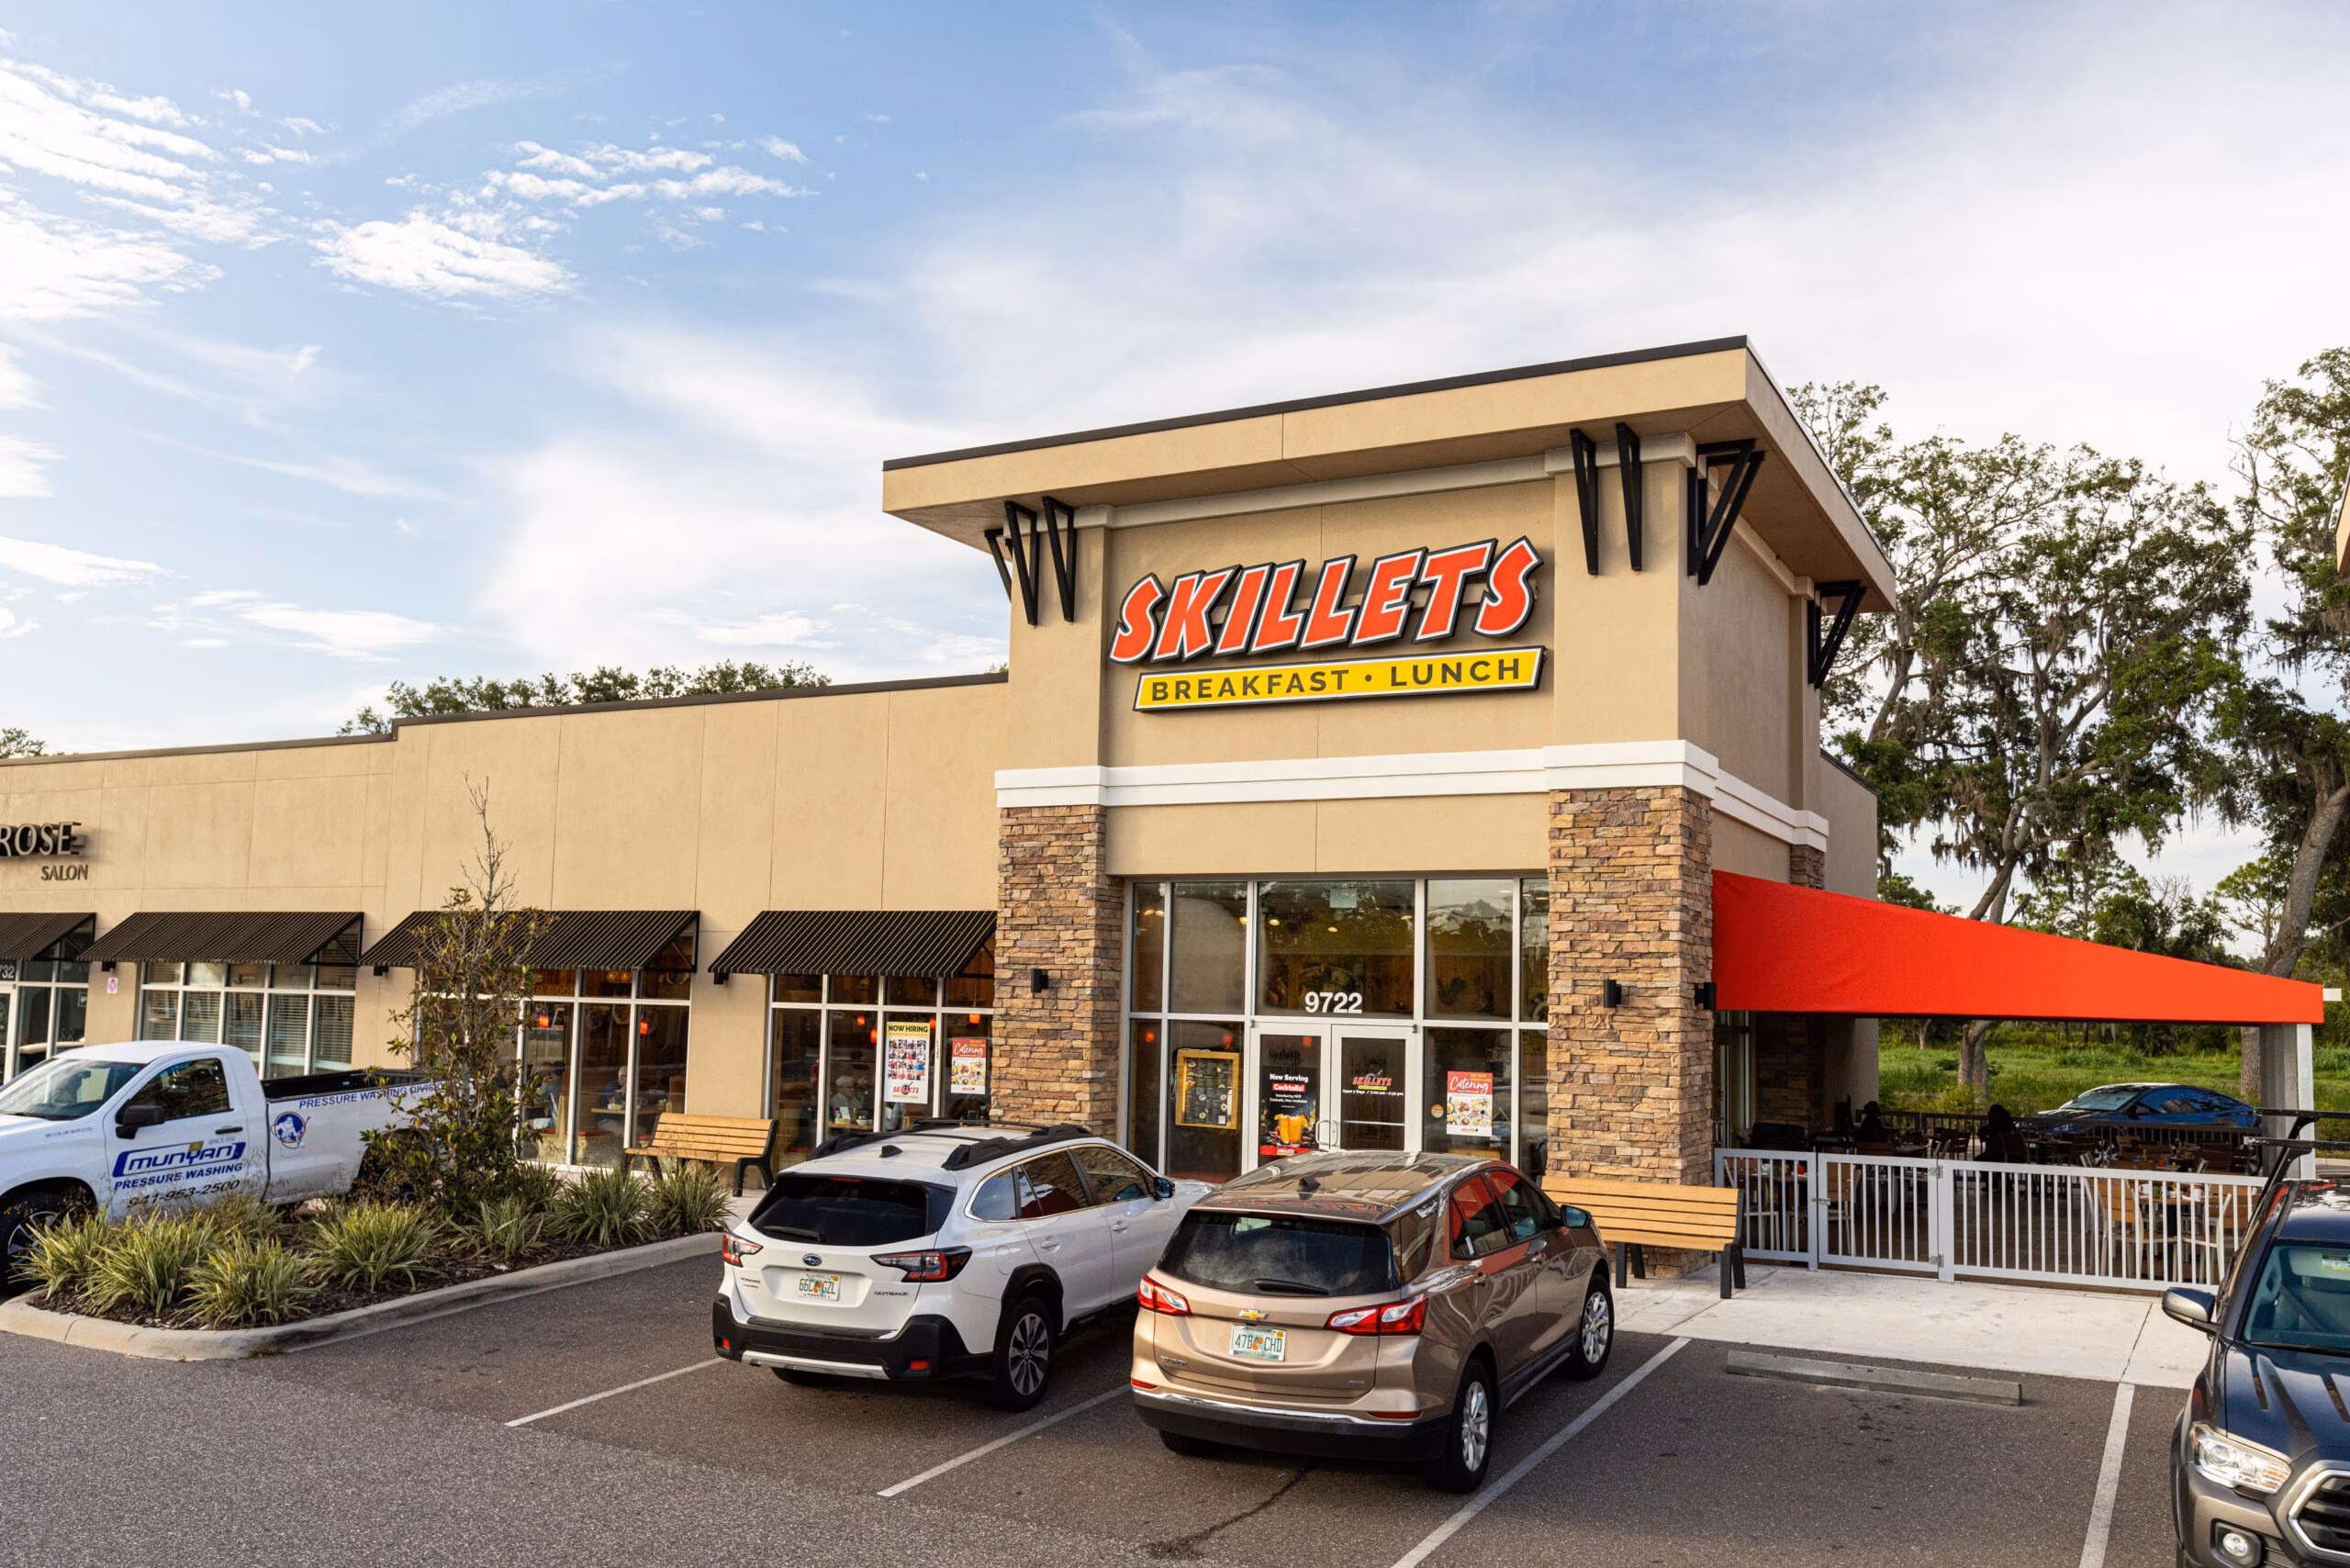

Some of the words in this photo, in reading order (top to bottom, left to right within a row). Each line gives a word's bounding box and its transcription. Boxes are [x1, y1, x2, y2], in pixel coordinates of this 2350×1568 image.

[1107, 535, 1546, 666] SKILLETS
[1150, 666, 1350, 702] BREAKFAST
[1390, 657, 1521, 688] LUNCH
[40, 865, 89, 881] SALON
[1304, 991, 1363, 1014] 9722
[888, 1025, 905, 1033] NOW
[954, 1042, 984, 1058] Catering
[1269, 1073, 1284, 1081] Now
[1283, 1074, 1309, 1083] Serving
[1352, 1076, 1393, 1087] SKILLETS
[1449, 1075, 1489, 1095] Catering
[298, 1093, 358, 1109] PRESSURE
[360, 1086, 408, 1101] WASHING
[409, 1081, 446, 1095] DIVISIO
[1272, 1083, 1304, 1092] Cocktails!
[114, 1171, 183, 1191] PRESSURE
[185, 1162, 243, 1180] WASHING
[1263, 1336, 1282, 1353] CHD
